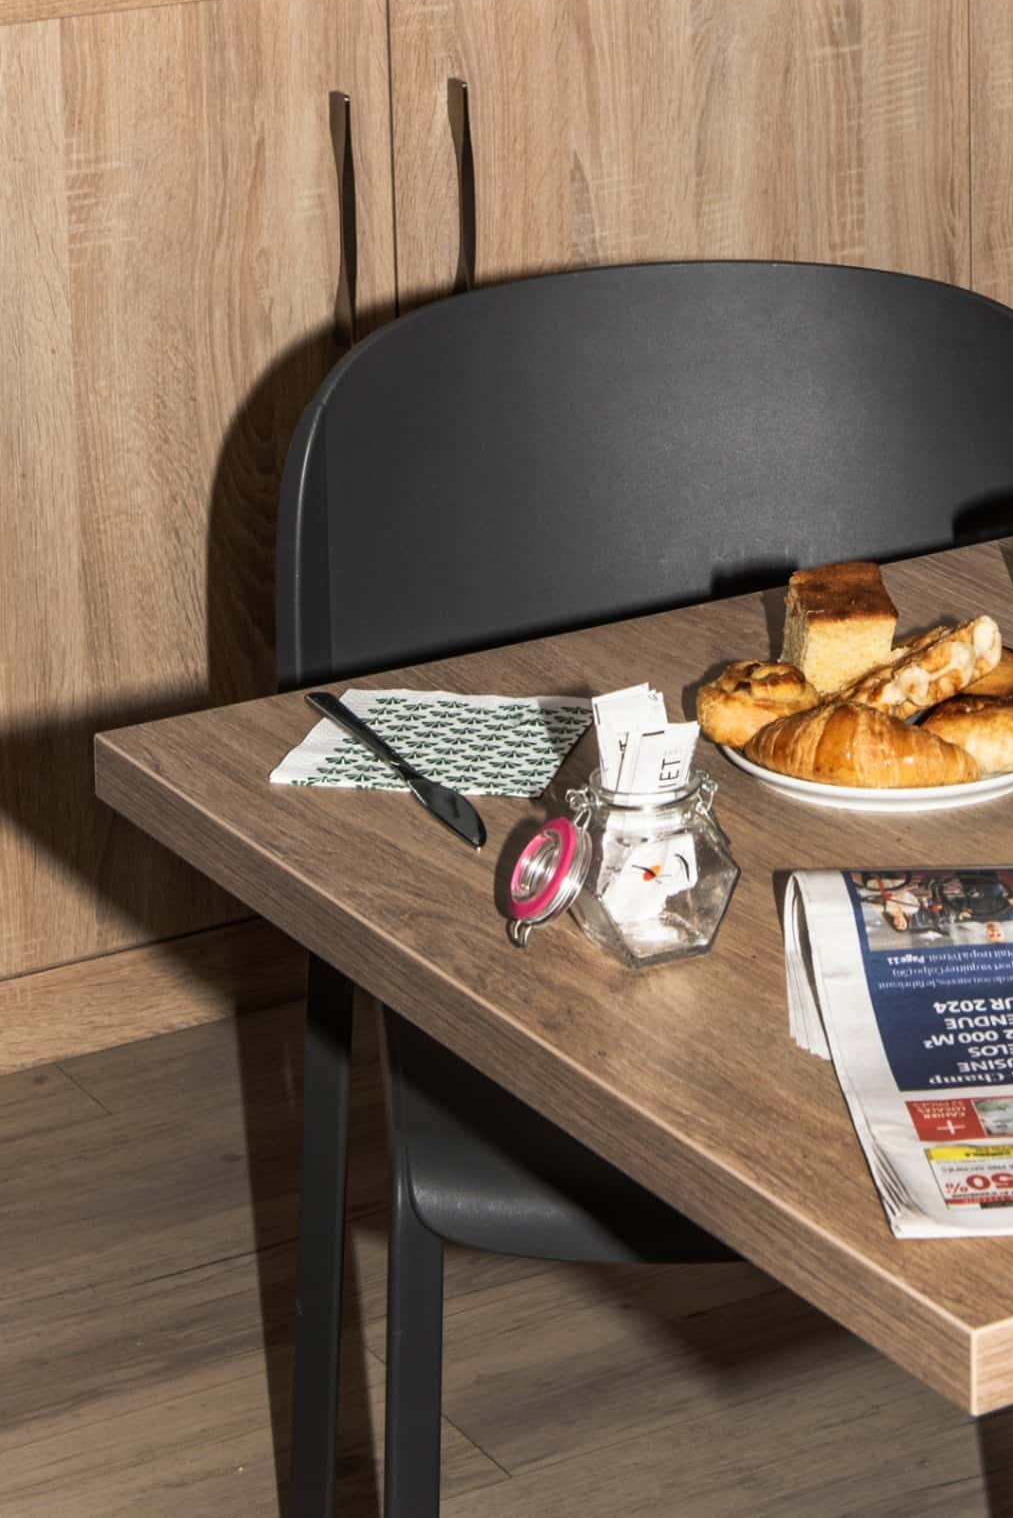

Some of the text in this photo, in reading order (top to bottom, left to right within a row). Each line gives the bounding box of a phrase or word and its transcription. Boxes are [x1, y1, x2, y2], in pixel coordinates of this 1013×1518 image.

[932, 998, 987, 1015] 2024
[957, 1030, 999, 1044] 000
[928, 1072, 1005, 1085] Champ
